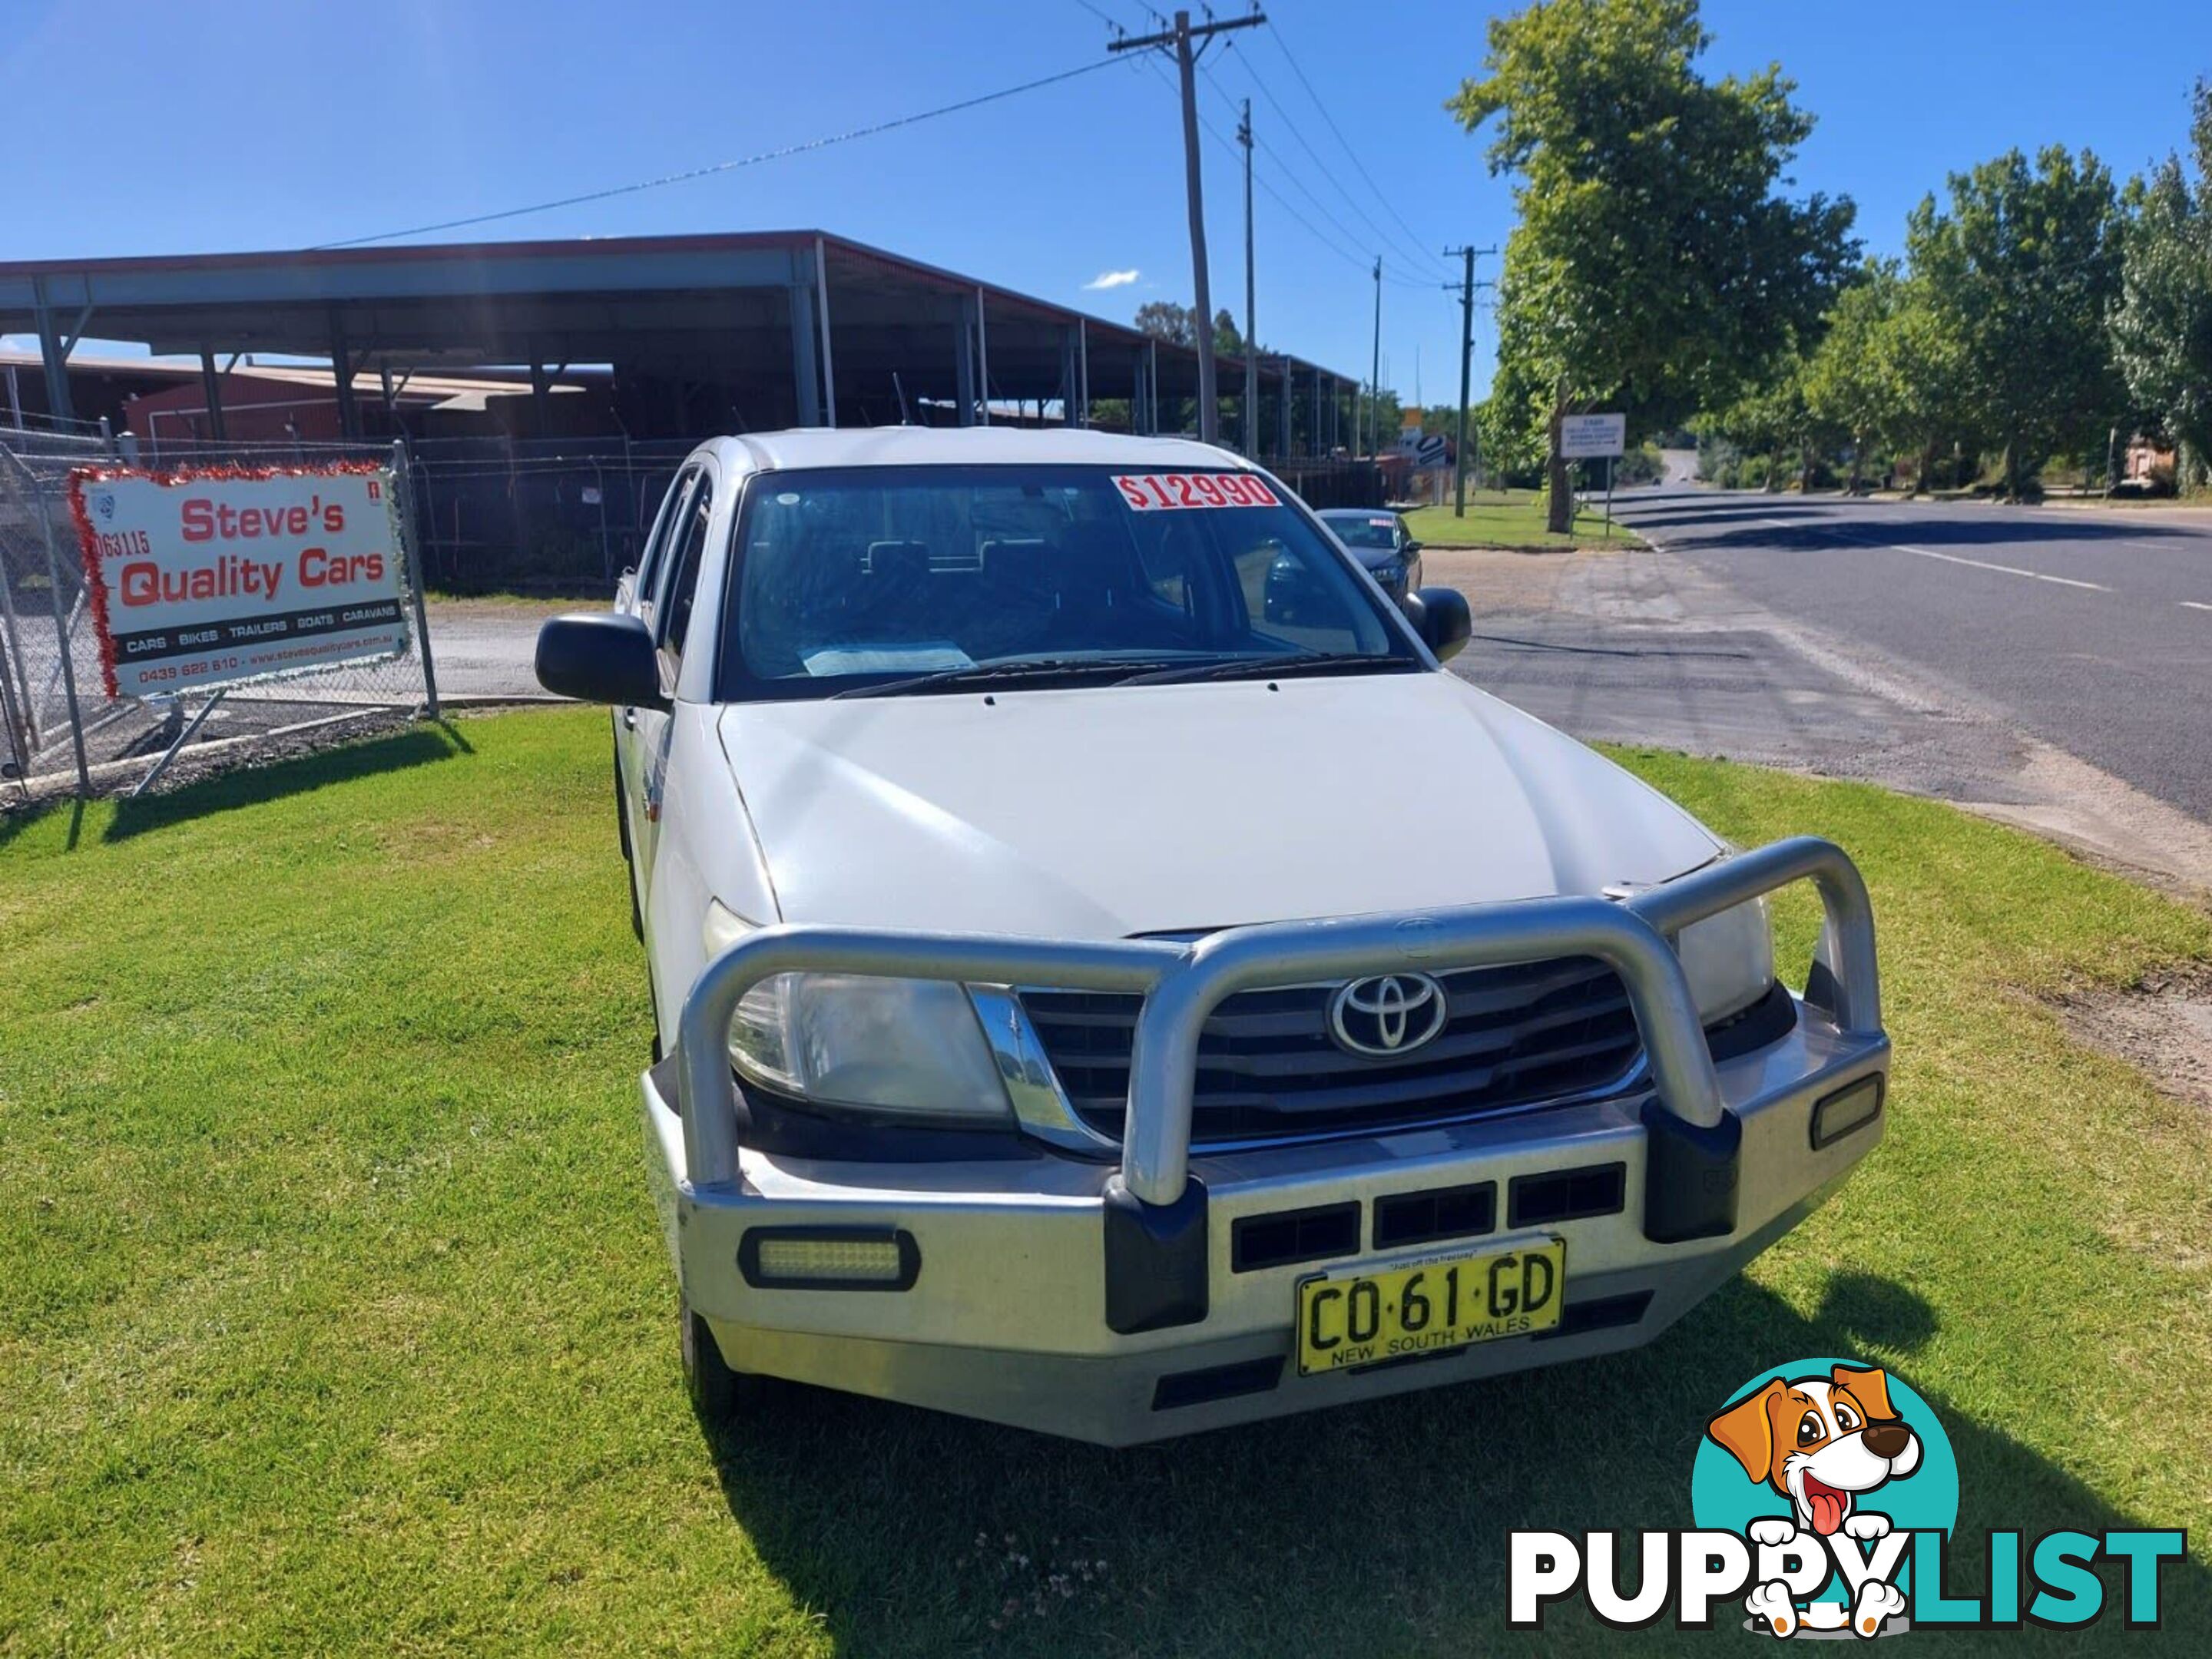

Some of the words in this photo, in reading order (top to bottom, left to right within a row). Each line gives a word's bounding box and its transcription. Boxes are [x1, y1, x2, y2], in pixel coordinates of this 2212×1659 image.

[1119, 475, 1277, 508] $12990
[181, 495, 345, 542] Steve's
[121, 555, 283, 608] Quality
[299, 547, 384, 588] Cars
[126, 637, 167, 654] CARS
[178, 630, 219, 646] BIKES
[229, 620, 287, 638] TRAILERS
[297, 614, 334, 629] BOATS
[343, 605, 396, 622] CARAVANS
[139, 667, 177, 684] 0439
[1331, 1346, 1376, 1367] NEW
[1388, 1330, 1456, 1355] SOUTH
[1465, 1315, 1532, 1339] WALES
